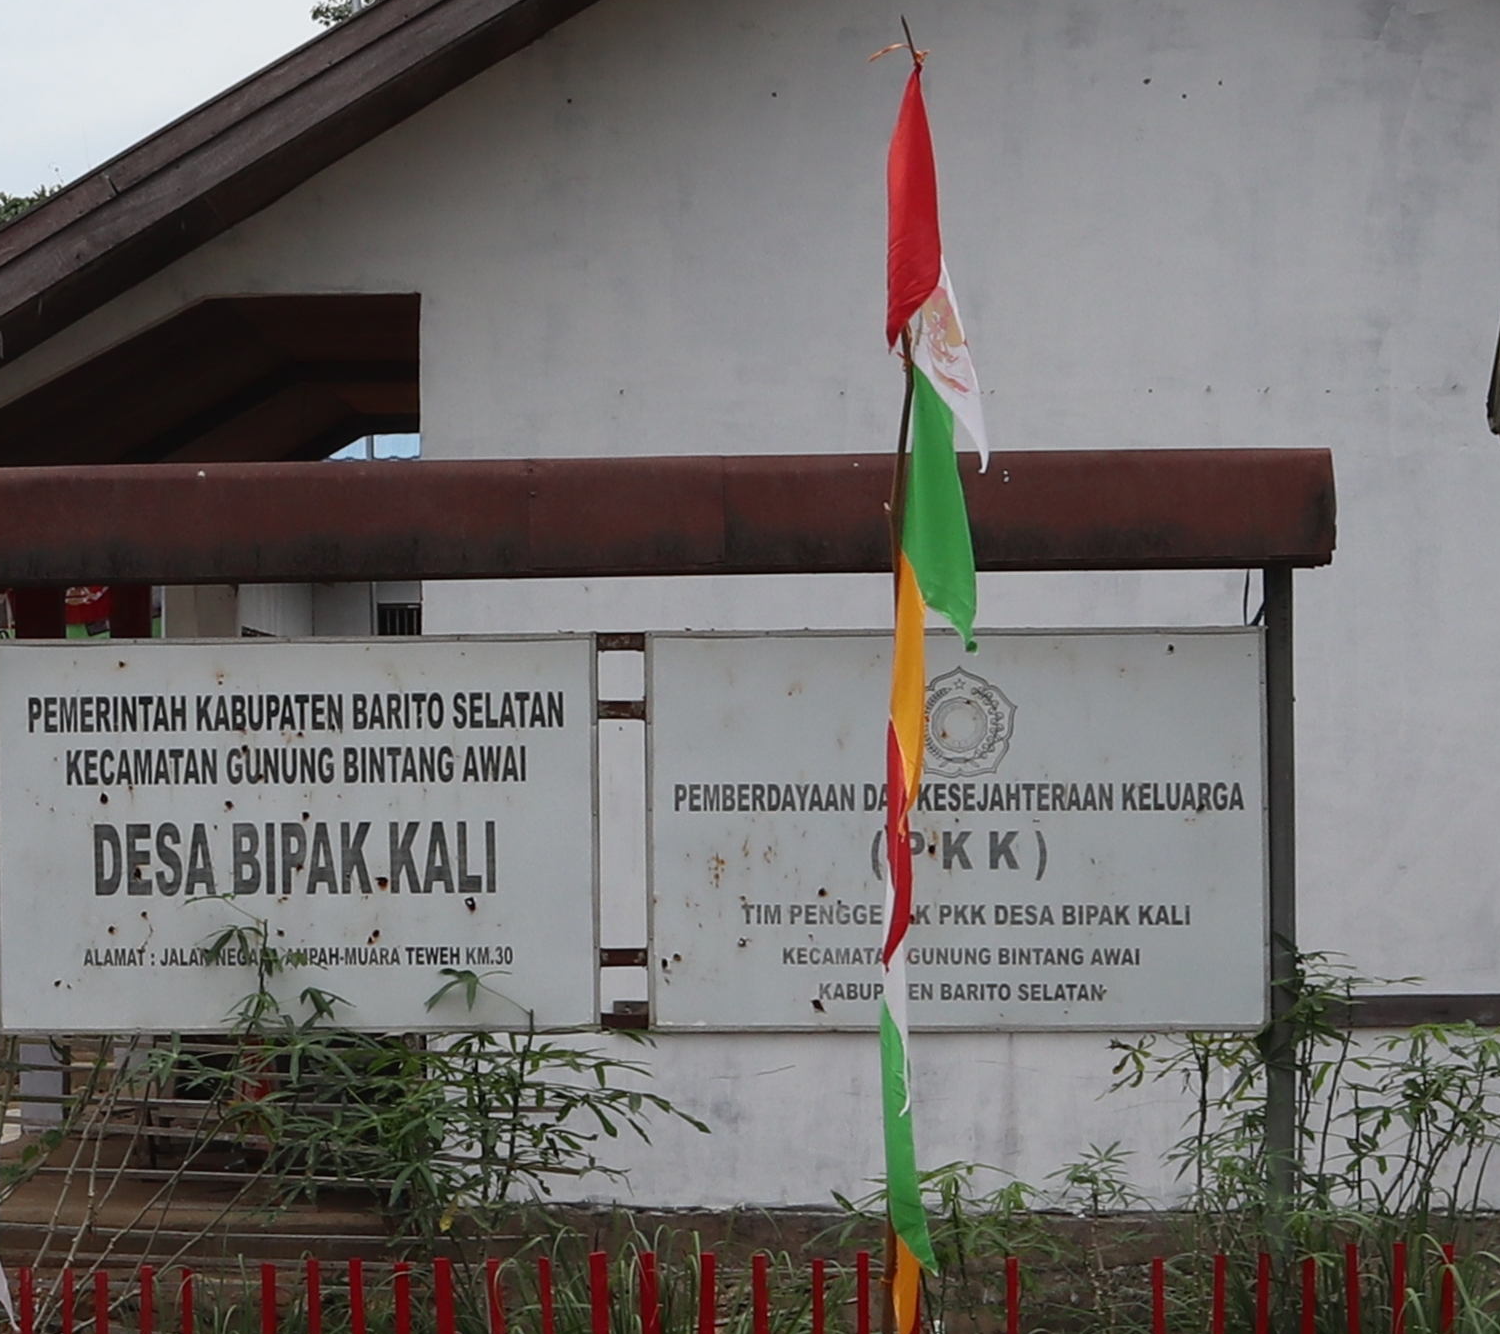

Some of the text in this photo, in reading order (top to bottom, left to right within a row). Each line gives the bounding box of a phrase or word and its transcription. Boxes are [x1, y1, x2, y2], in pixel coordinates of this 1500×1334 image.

[28, 692, 564, 733] PEMERINTAH KABUPATEN BARITO SELATAN
[66, 745, 526, 785] KECAMATAN GUNUNG BINTANG AWAI
[674, 783, 1244, 812] PEMBERDAYAAN DA KESEJAHTERAAN KELUARGA
[93, 821, 496, 896] DESA BIPAK KALI
[742, 905, 782, 926] TIM
[939, 905, 986, 925] PKK
[994, 905, 1054, 925] DESA
[1062, 905, 1130, 925] BIPAK
[1138, 905, 1191, 925] KALI
[84, 948, 145, 967] ALAMAT
[215, 947, 279, 966] NEGA
[406, 946, 460, 965] TEWEH
[465, 946, 513, 965] KM.30
[783, 947, 1140, 966] KECAMATA GUNUNG BINTANG AWAI
[819, 983, 1105, 1003] KABUPEN BARITO SELATAN
